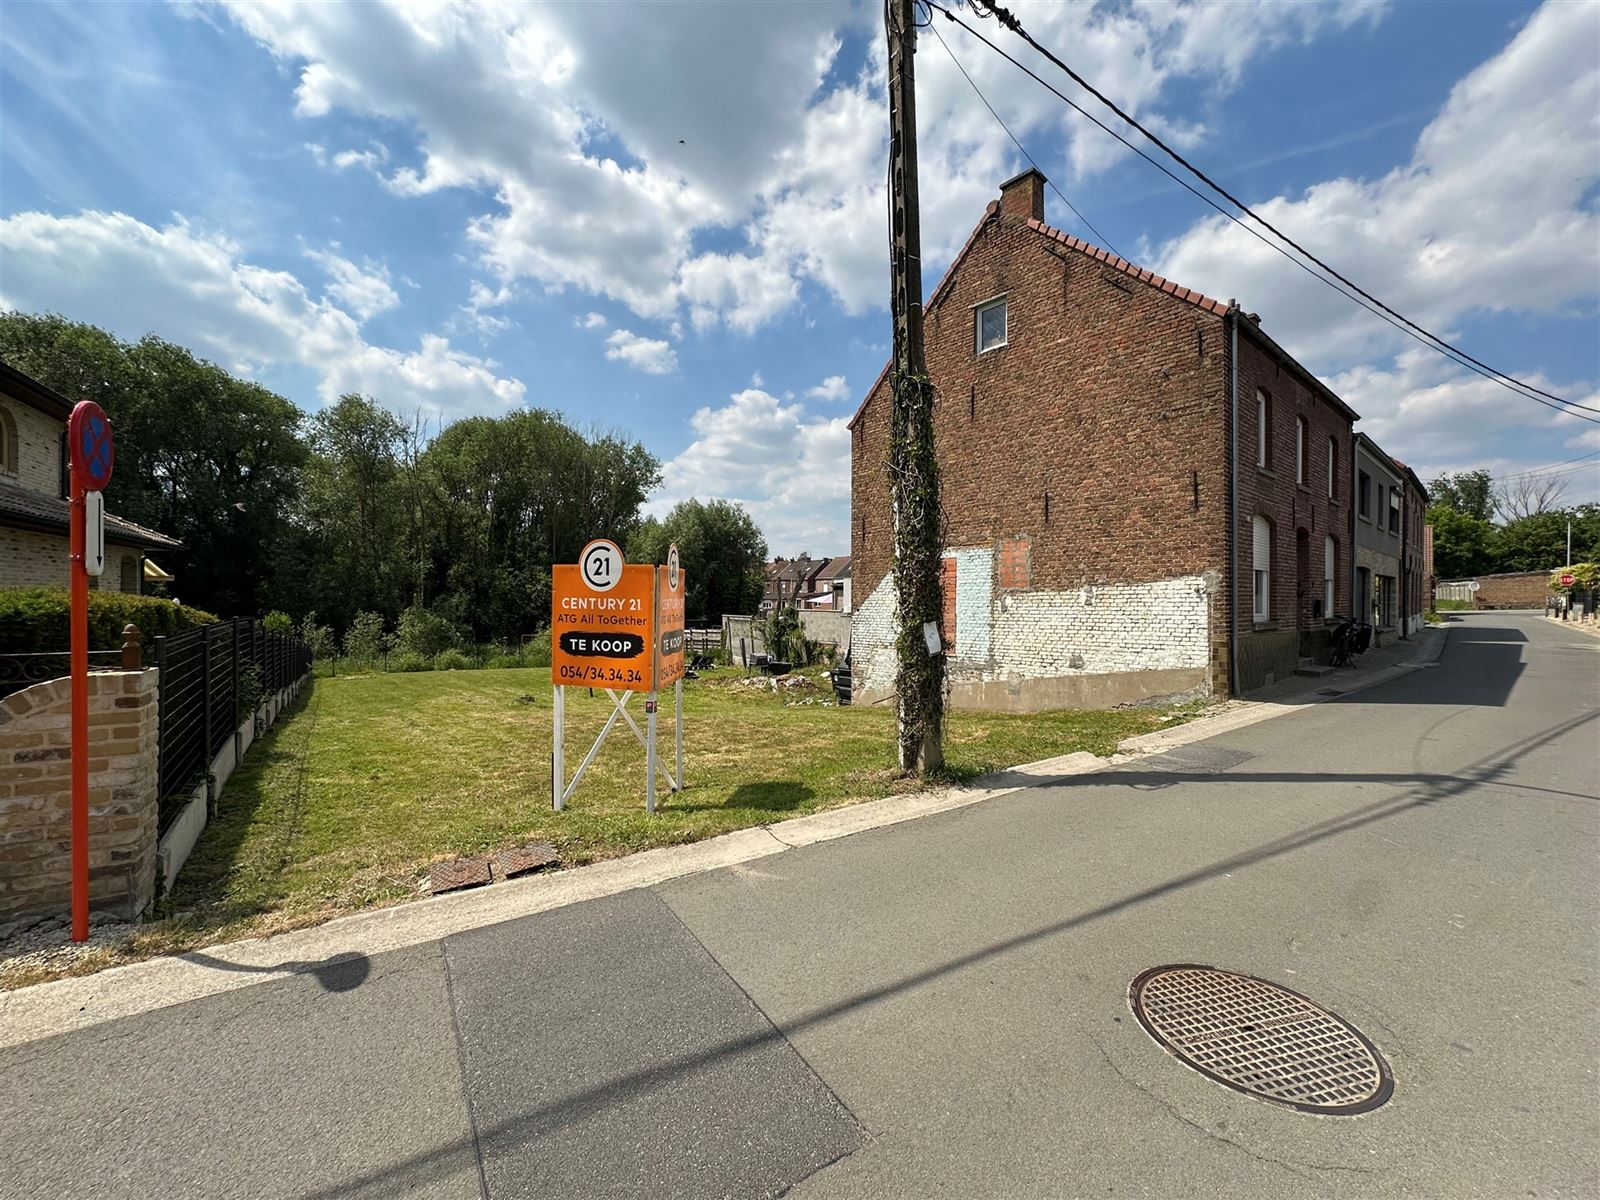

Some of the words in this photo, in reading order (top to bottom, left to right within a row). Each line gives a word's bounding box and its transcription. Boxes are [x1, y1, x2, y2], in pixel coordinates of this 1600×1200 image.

[561, 597, 626, 611] CENTURY
[629, 599, 641, 611] 21
[557, 613, 577, 624] ATG
[580, 614, 594, 624] All
[598, 614, 648, 626] ToGether
[569, 638, 587, 651] TE
[591, 639, 632, 653] KOOP
[560, 665, 642, 683] 054/34.34.34
